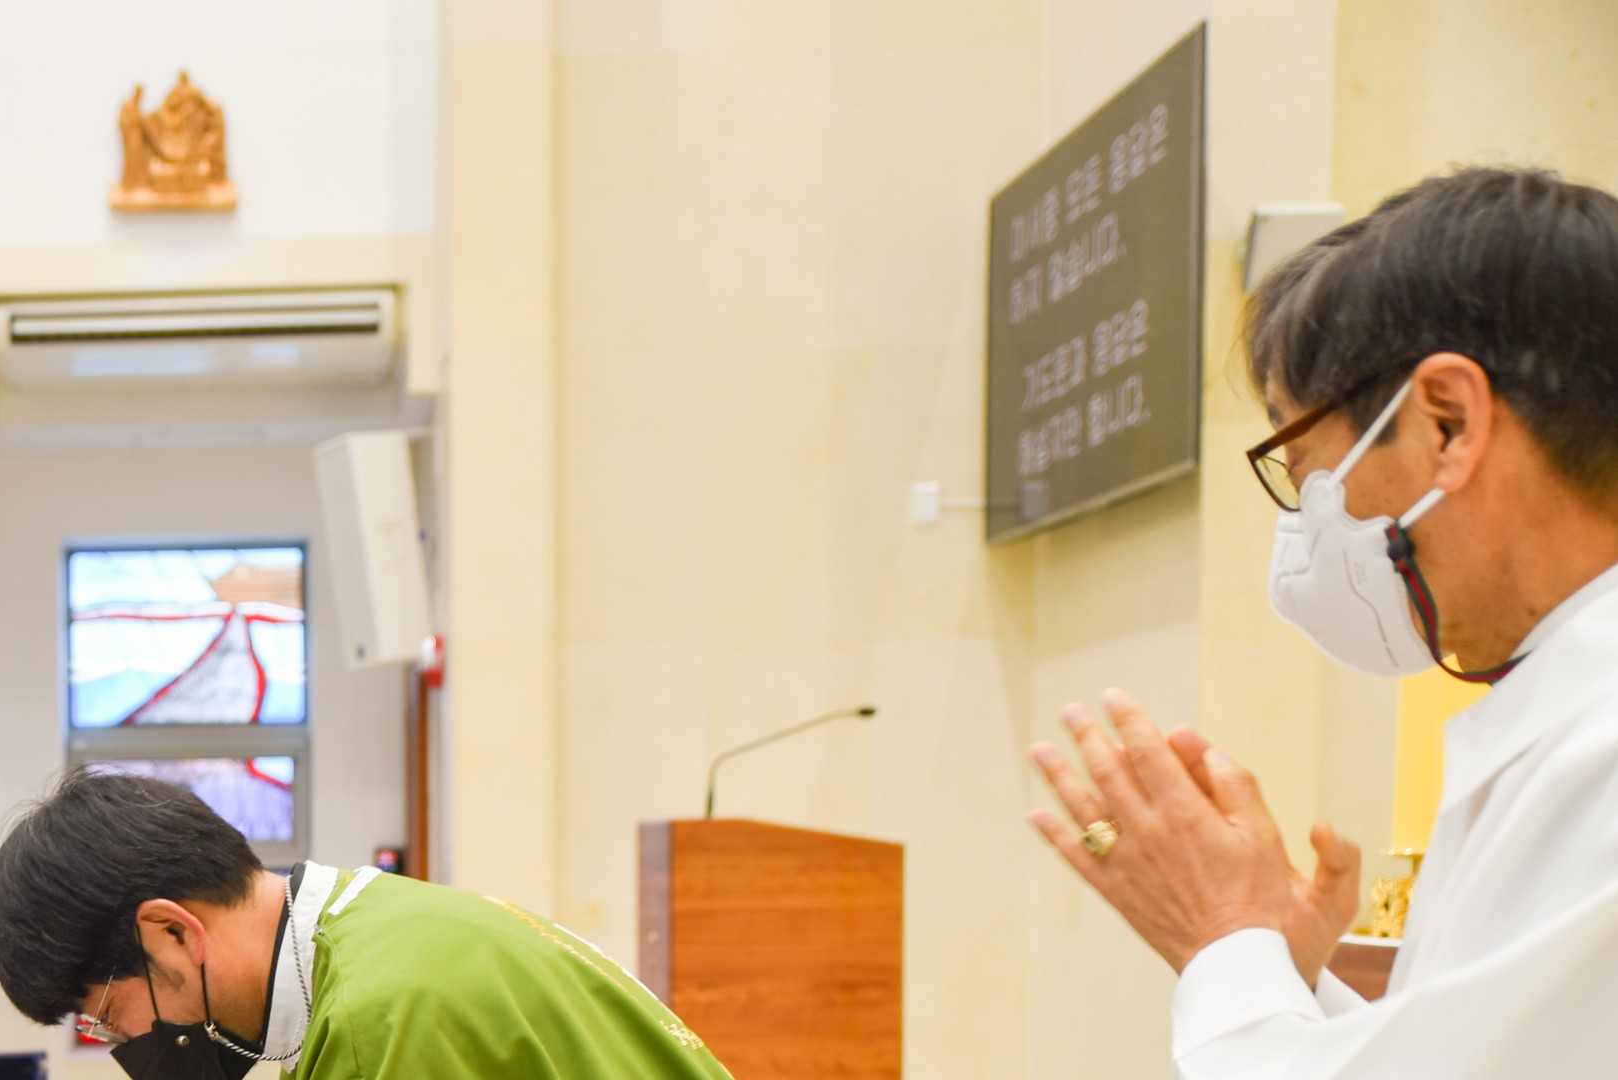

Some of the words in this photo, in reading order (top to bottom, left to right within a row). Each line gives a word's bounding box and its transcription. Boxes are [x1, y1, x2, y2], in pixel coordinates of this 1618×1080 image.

[1010, 185, 1060, 264] 미사중
[1064, 153, 1102, 225] 모든
[1108, 103, 1170, 194] 응답은
[1092, 298, 1149, 378] 응답은
